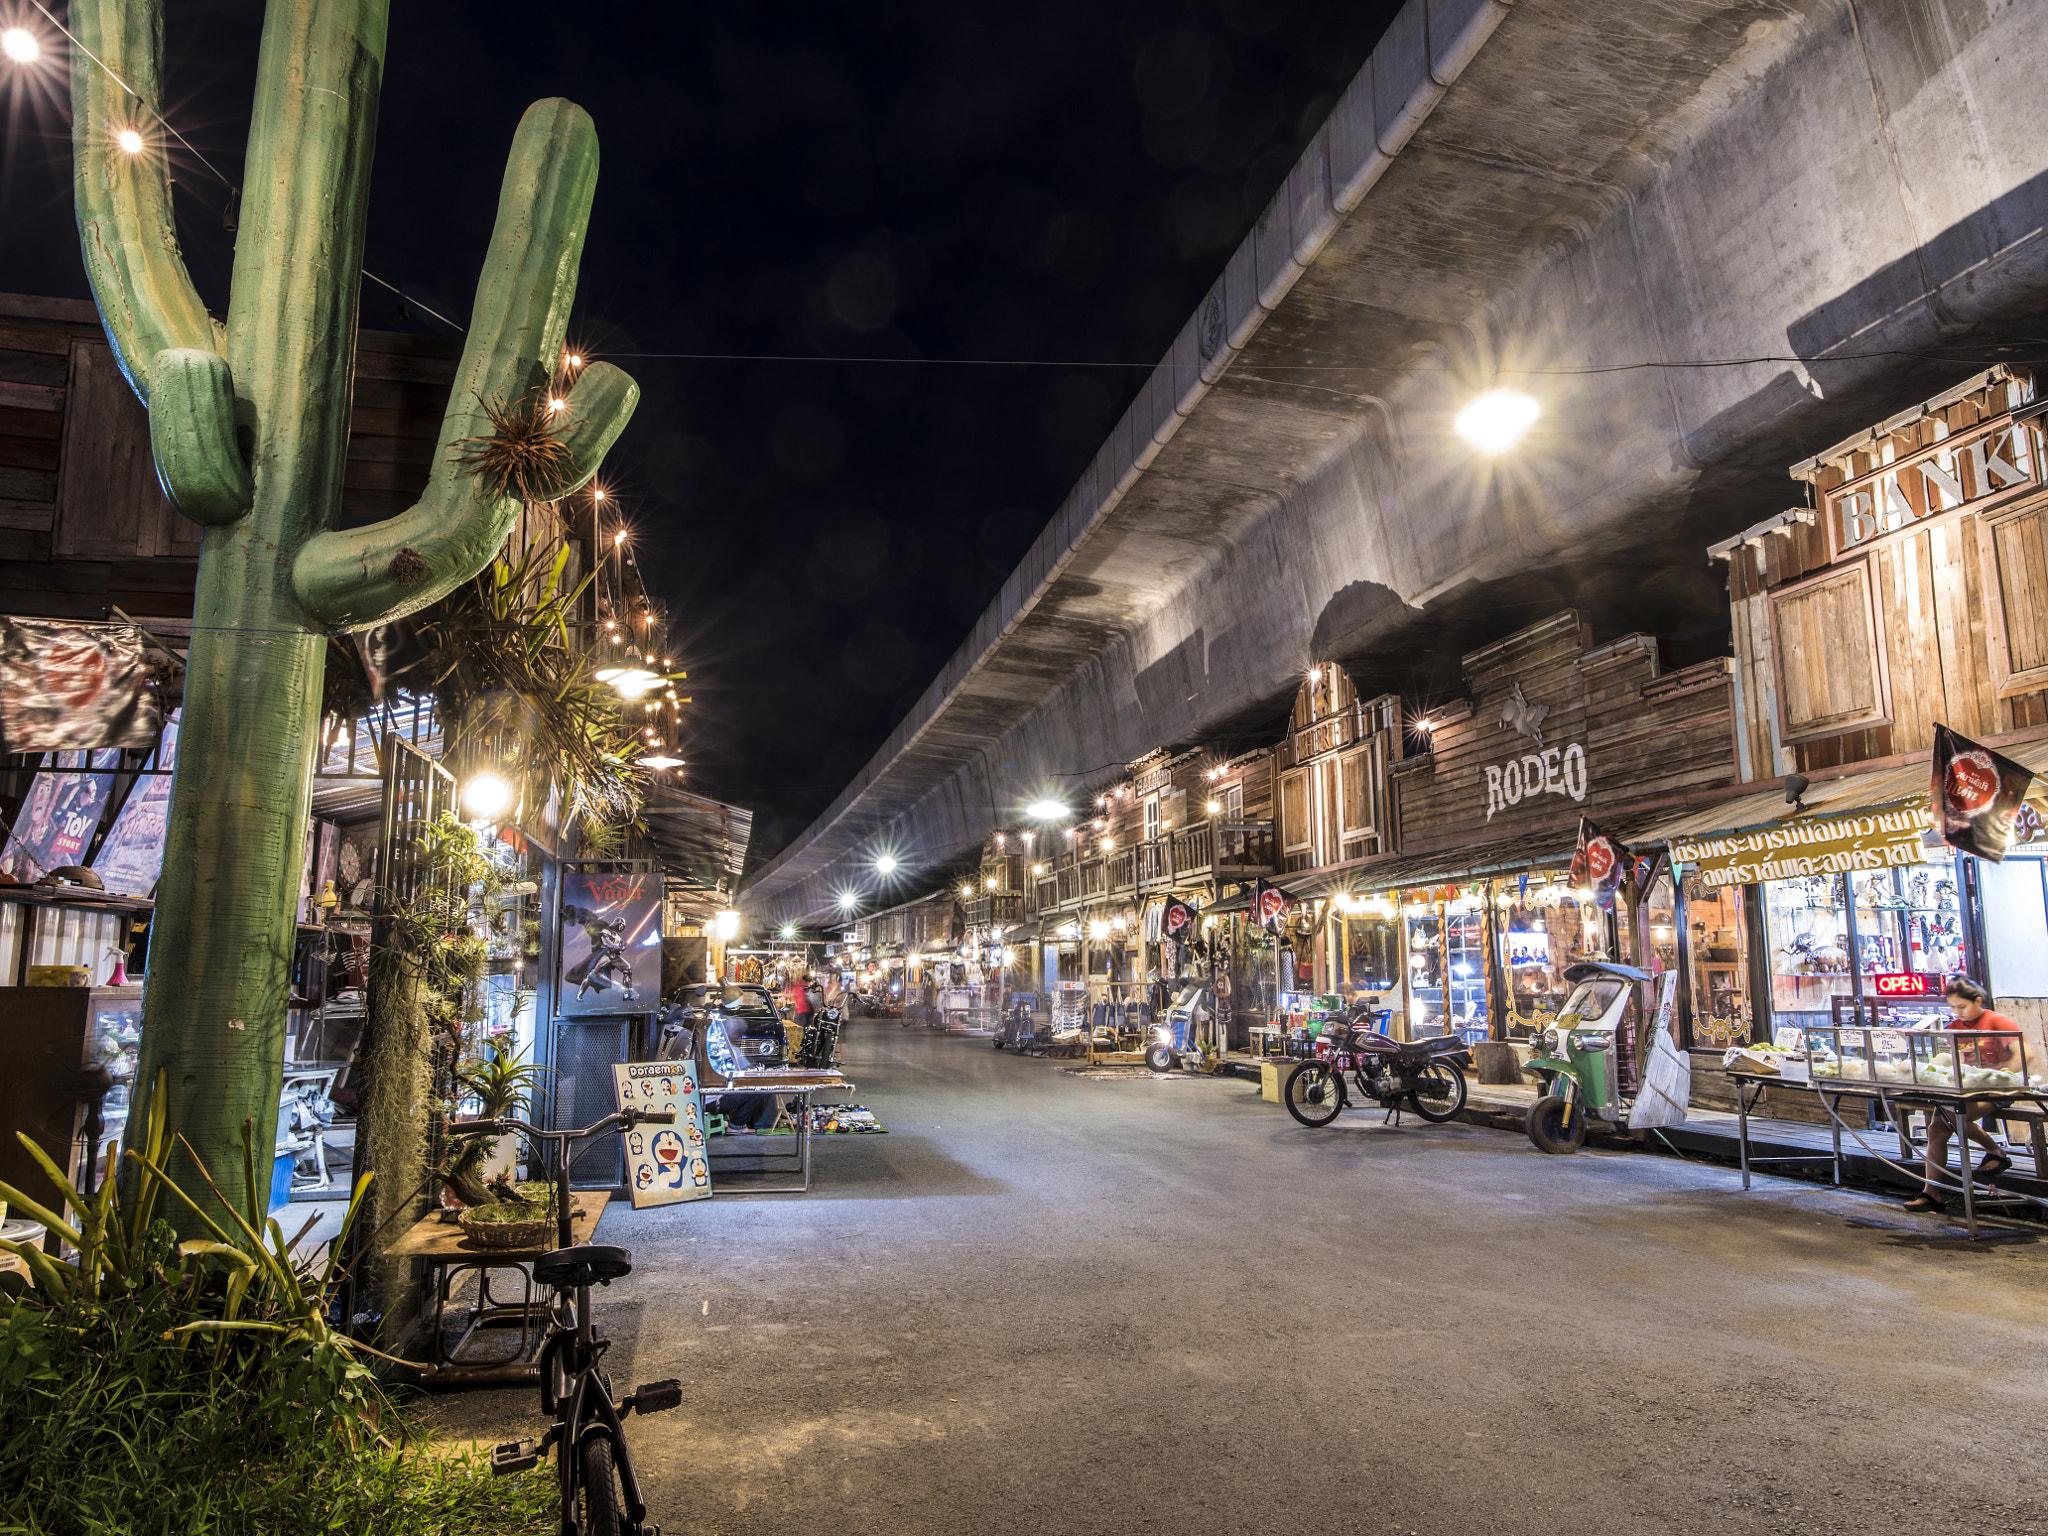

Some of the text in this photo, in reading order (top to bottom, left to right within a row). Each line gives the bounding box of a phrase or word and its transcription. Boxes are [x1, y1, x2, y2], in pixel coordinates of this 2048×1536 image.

[1836, 427, 2030, 551] BANK
[1484, 742, 1587, 822] RODEO
[1957, 786, 1979, 801] LOVE
[63, 811, 93, 839] TOY
[56, 837, 81, 850] STORY
[580, 879, 646, 903] Vader
[1879, 976, 1924, 992] OPEN
[629, 1063, 685, 1078] Doraemon
